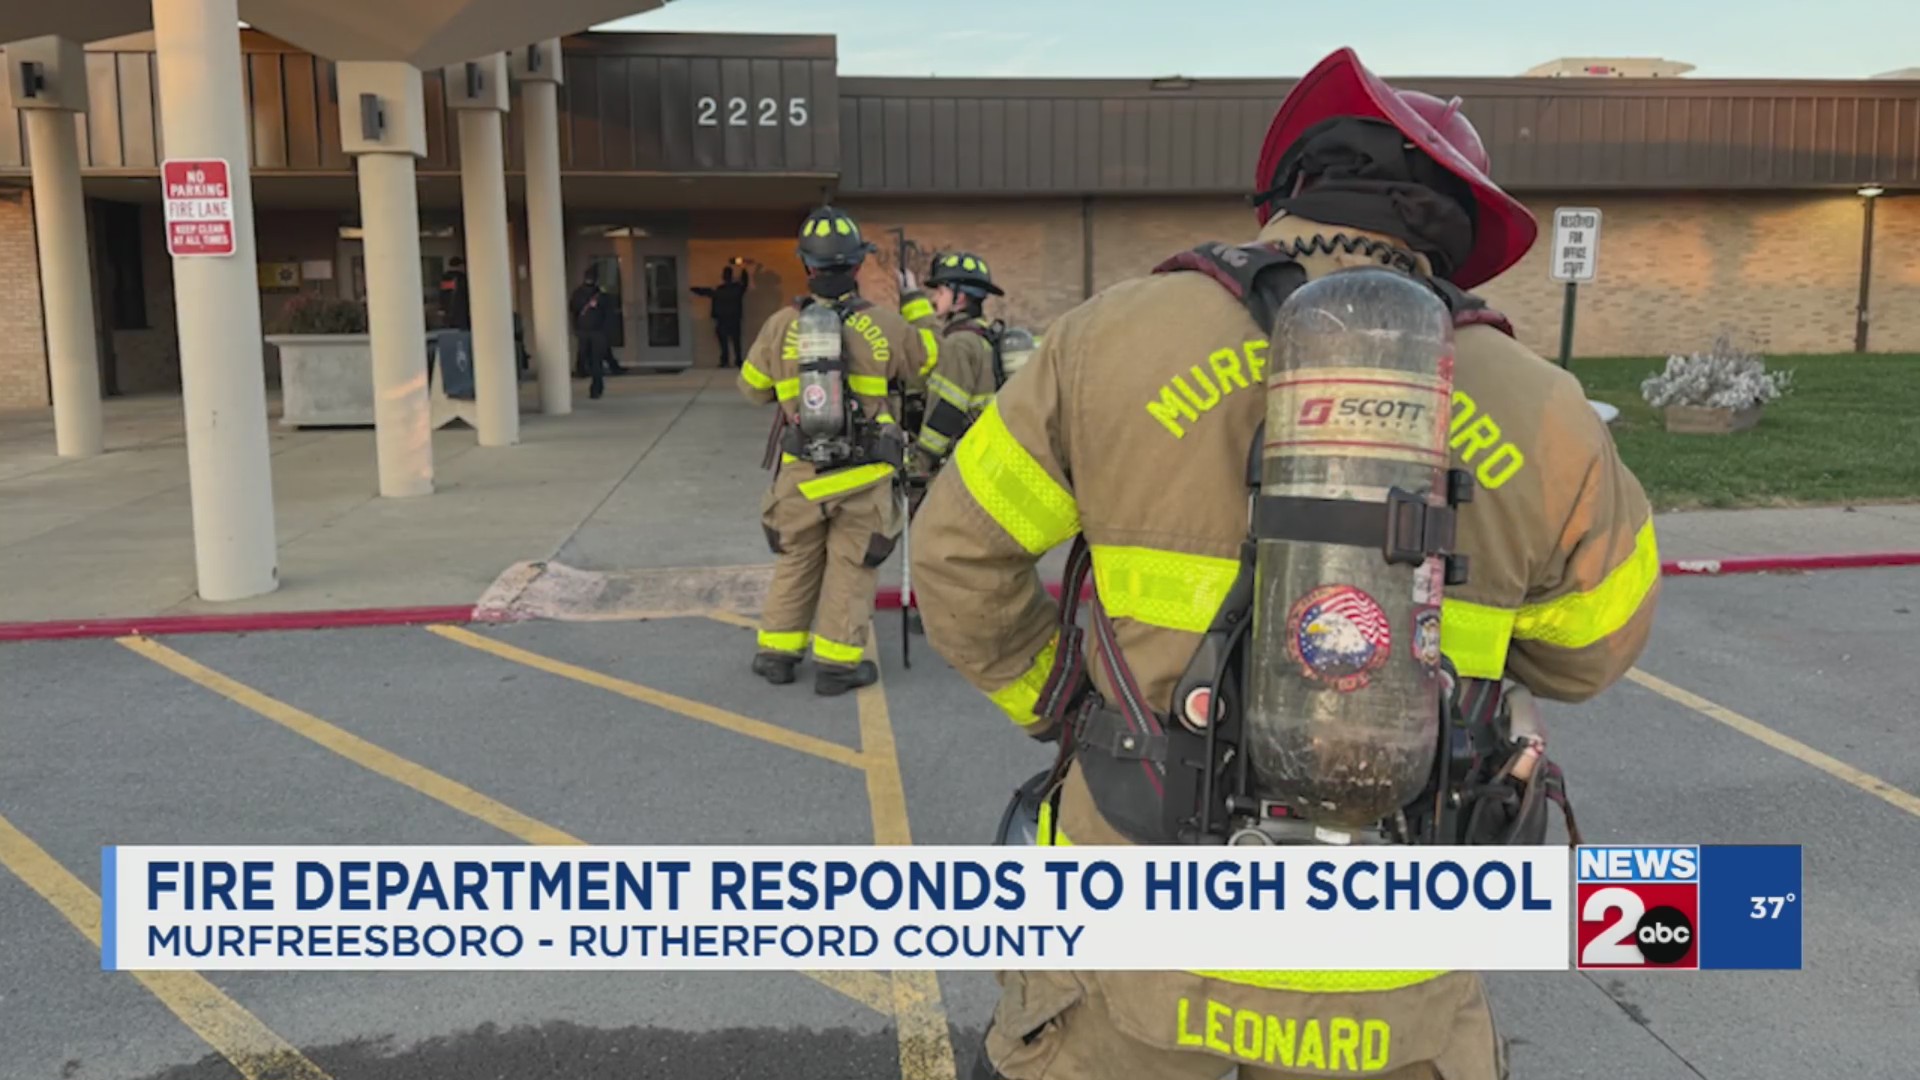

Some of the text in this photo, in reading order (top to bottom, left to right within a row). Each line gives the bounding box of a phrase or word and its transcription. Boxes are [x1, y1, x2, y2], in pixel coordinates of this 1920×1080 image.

[698, 97, 808, 126] 2225
[186, 169, 205, 184] NO
[170, 183, 225, 197] PARKING
[169, 201, 228, 218] FIRE LANE
[1561, 215, 1595, 229] RESERVED
[173, 235, 184, 246] AT
[1568, 231, 1583, 244] FOR
[1563, 247, 1586, 259] OFFICE
[1338, 397, 1426, 422] SCOTT
[1176, 998, 1391, 1072] LEONARD
